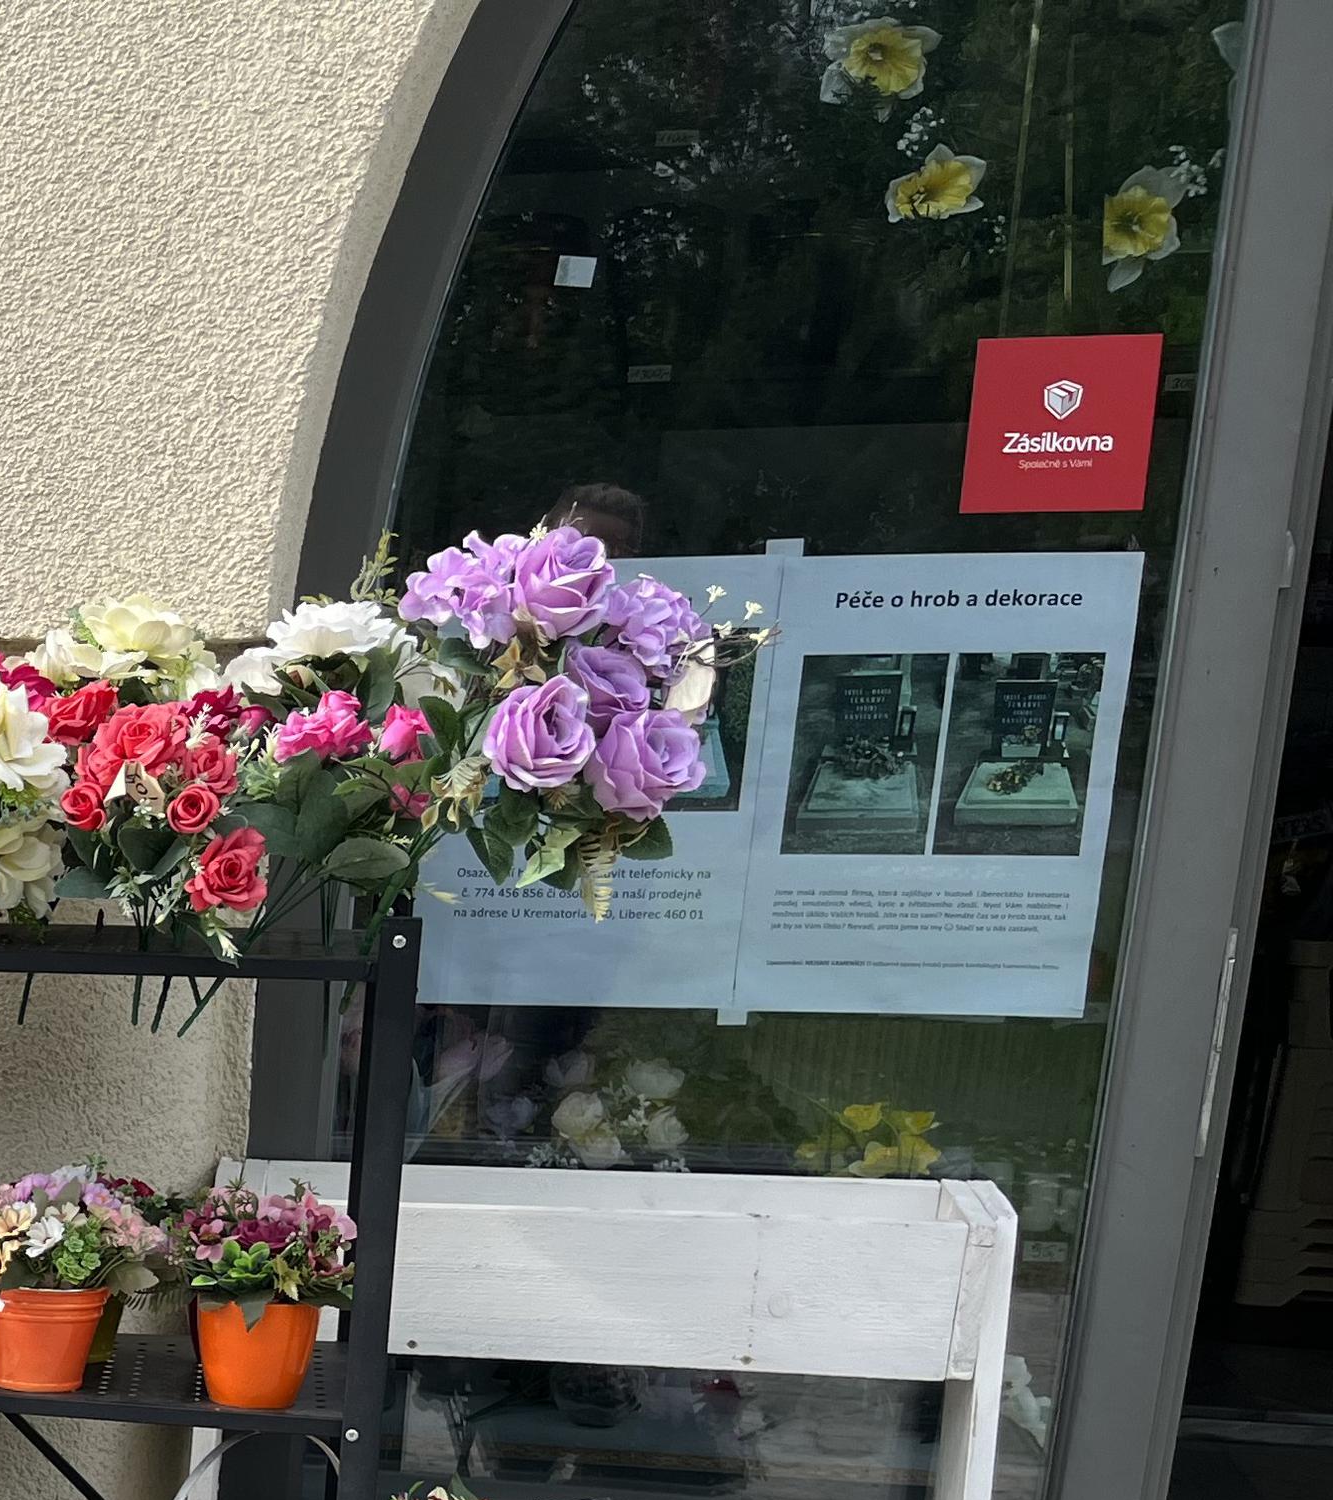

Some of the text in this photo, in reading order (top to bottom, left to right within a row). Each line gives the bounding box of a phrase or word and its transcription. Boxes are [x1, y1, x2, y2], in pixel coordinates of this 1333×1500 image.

[1002, 431, 1114, 454] Zásilkovna
[1019, 458, 1093, 471] Společně s Vámi
[835, 589, 1084, 609] Péče o hrob a dekorace
[629, 868, 693, 880] telefonicky
[696, 870, 711, 879] na
[474, 887, 495, 898] 774
[498, 887, 519, 898] 456
[522, 887, 544, 898] 856
[622, 888, 645, 899] naší
[648, 888, 703, 901] prodejně
[454, 909, 467, 918] na
[470, 907, 508, 918] adrese
[511, 908, 522, 918] U
[524, 907, 587, 919] Krematoria
[619, 909, 661, 920] Liberec
[664, 909, 686, 920] 460
[689, 909, 704, 920] 01
